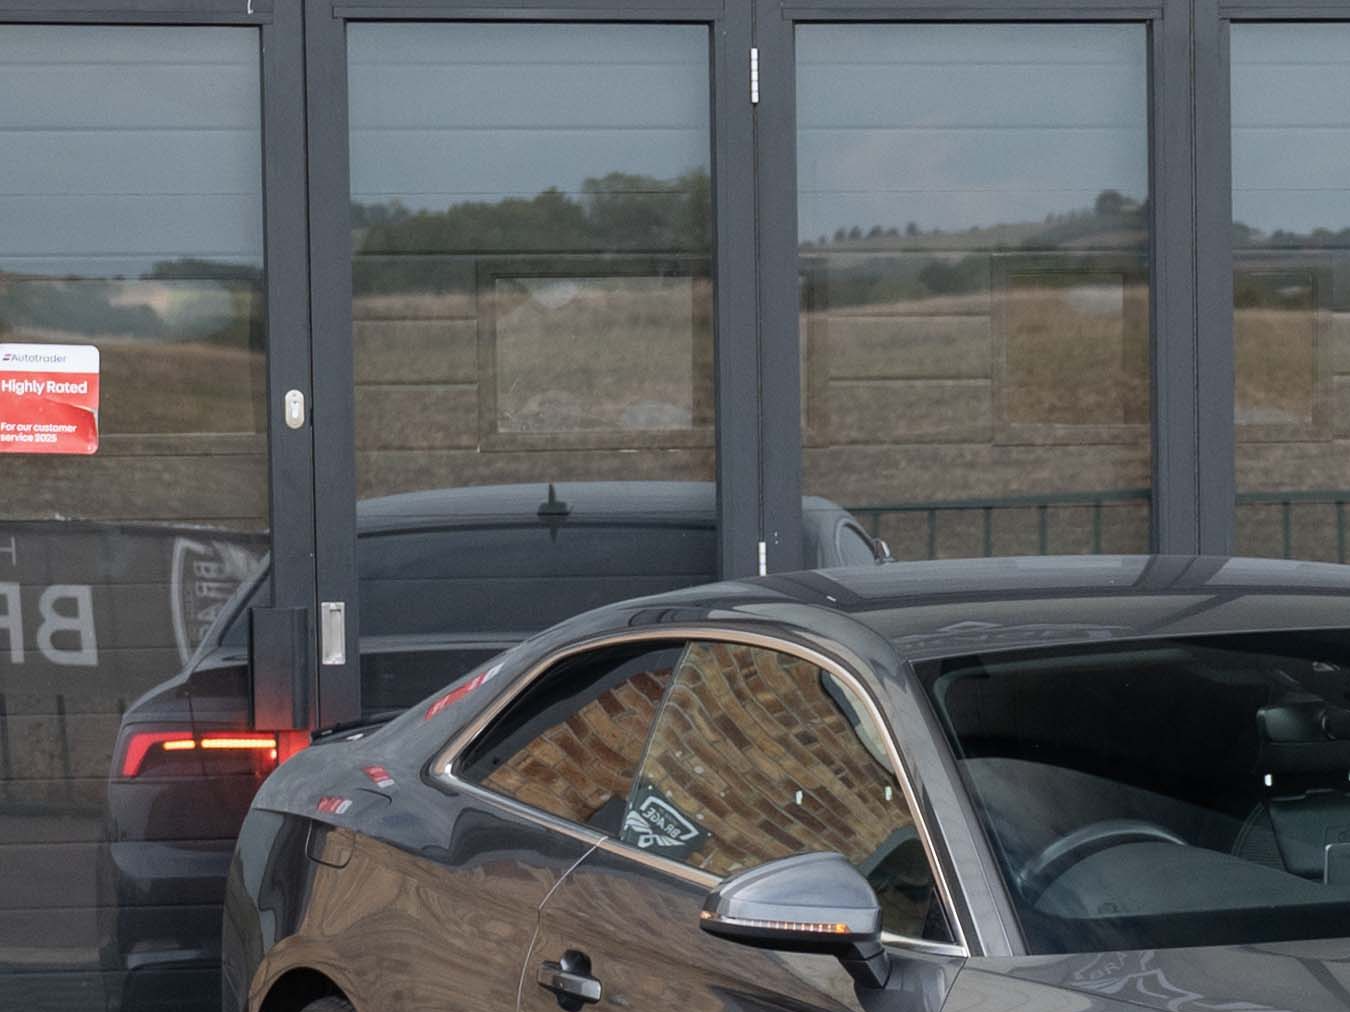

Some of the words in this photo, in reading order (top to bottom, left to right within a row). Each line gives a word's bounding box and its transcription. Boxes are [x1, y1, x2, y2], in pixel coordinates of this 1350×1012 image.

[11, 353, 66, 363] Autotrader
[2, 379, 45, 395] Highly
[47, 380, 88, 394] Rated
[1, 422, 16, 432] For
[17, 424, 32, 432] our
[33, 423, 77, 433] customer
